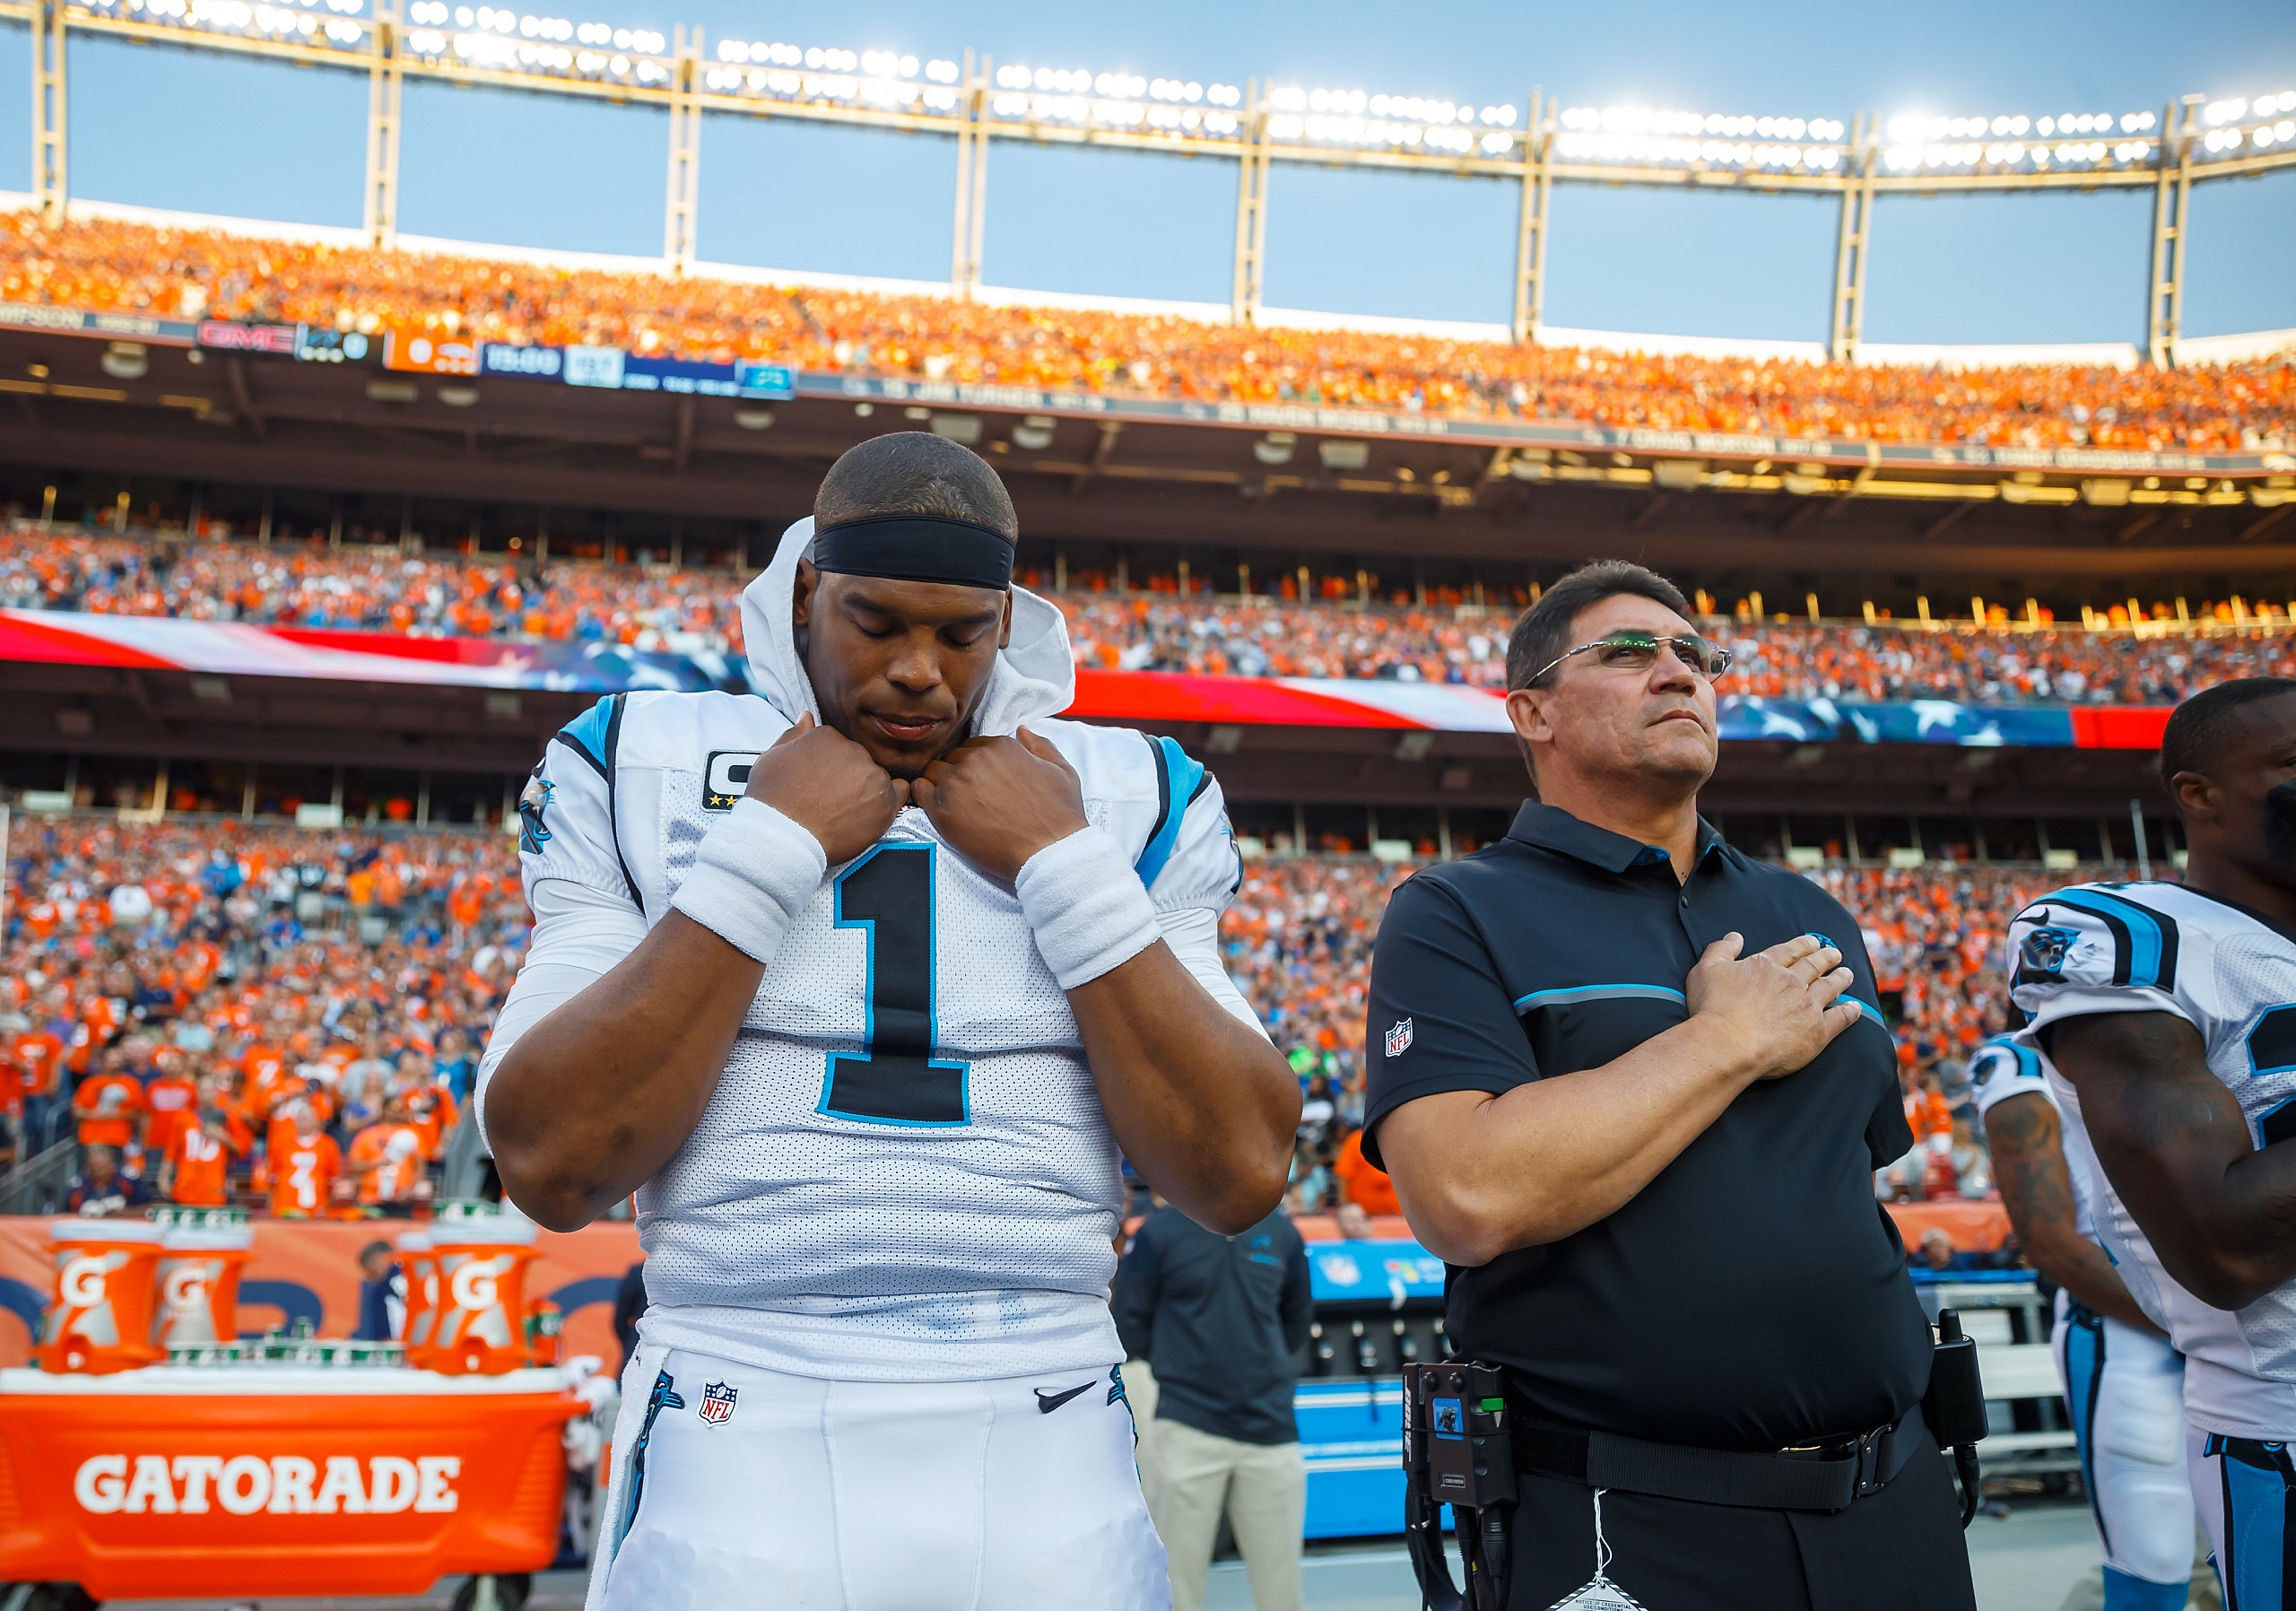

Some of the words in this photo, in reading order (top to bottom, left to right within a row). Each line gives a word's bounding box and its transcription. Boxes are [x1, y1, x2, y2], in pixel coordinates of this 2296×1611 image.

[709, 753, 760, 795] C
[815, 841, 971, 1128] 1
[1390, 1033, 1409, 1052] NFL
[60, 1256, 107, 1308] G
[164, 1267, 208, 1312] G
[451, 1259, 498, 1311] G
[702, 1398, 730, 1420] NFL
[74, 1454, 461, 1515] GATORADE
